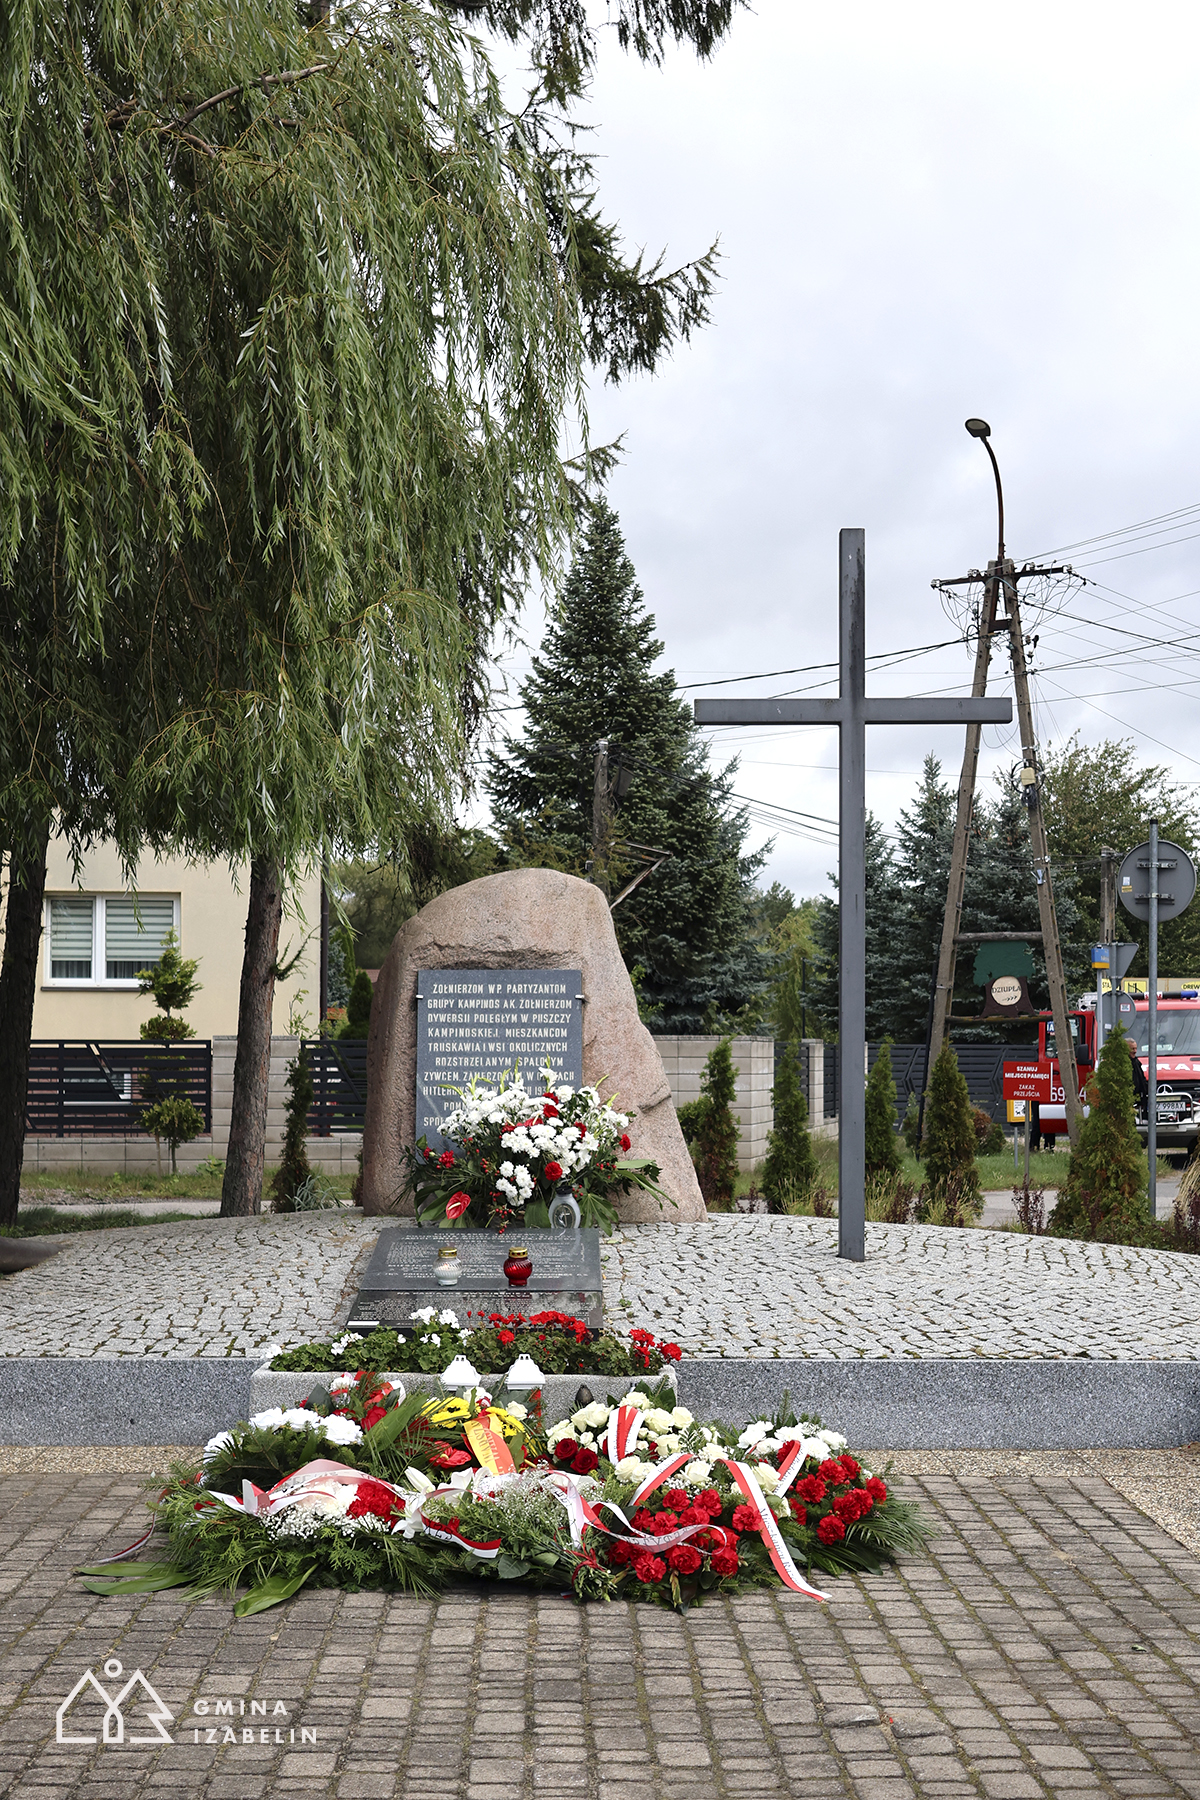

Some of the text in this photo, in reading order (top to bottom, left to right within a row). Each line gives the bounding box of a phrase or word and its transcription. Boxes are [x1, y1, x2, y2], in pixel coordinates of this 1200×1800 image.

[506, 984, 566, 994] PARTYZANTOM
[427, 999, 455, 1009] GRUPY
[458, 999, 500, 1009] KAMPINOS
[474, 1013, 518, 1023] POLEGŁYM
[520, 1013, 529, 1023] W
[532, 1013, 572, 1023] PUSZCZY
[428, 1042, 480, 1052] TRUSKAWIA
[488, 1042, 505, 1052] WSI
[509, 1042, 568, 1052] OKOLICZNYCH
[517, 1056, 564, 1067] SPALOYM
[526, 1071, 535, 1081] W
